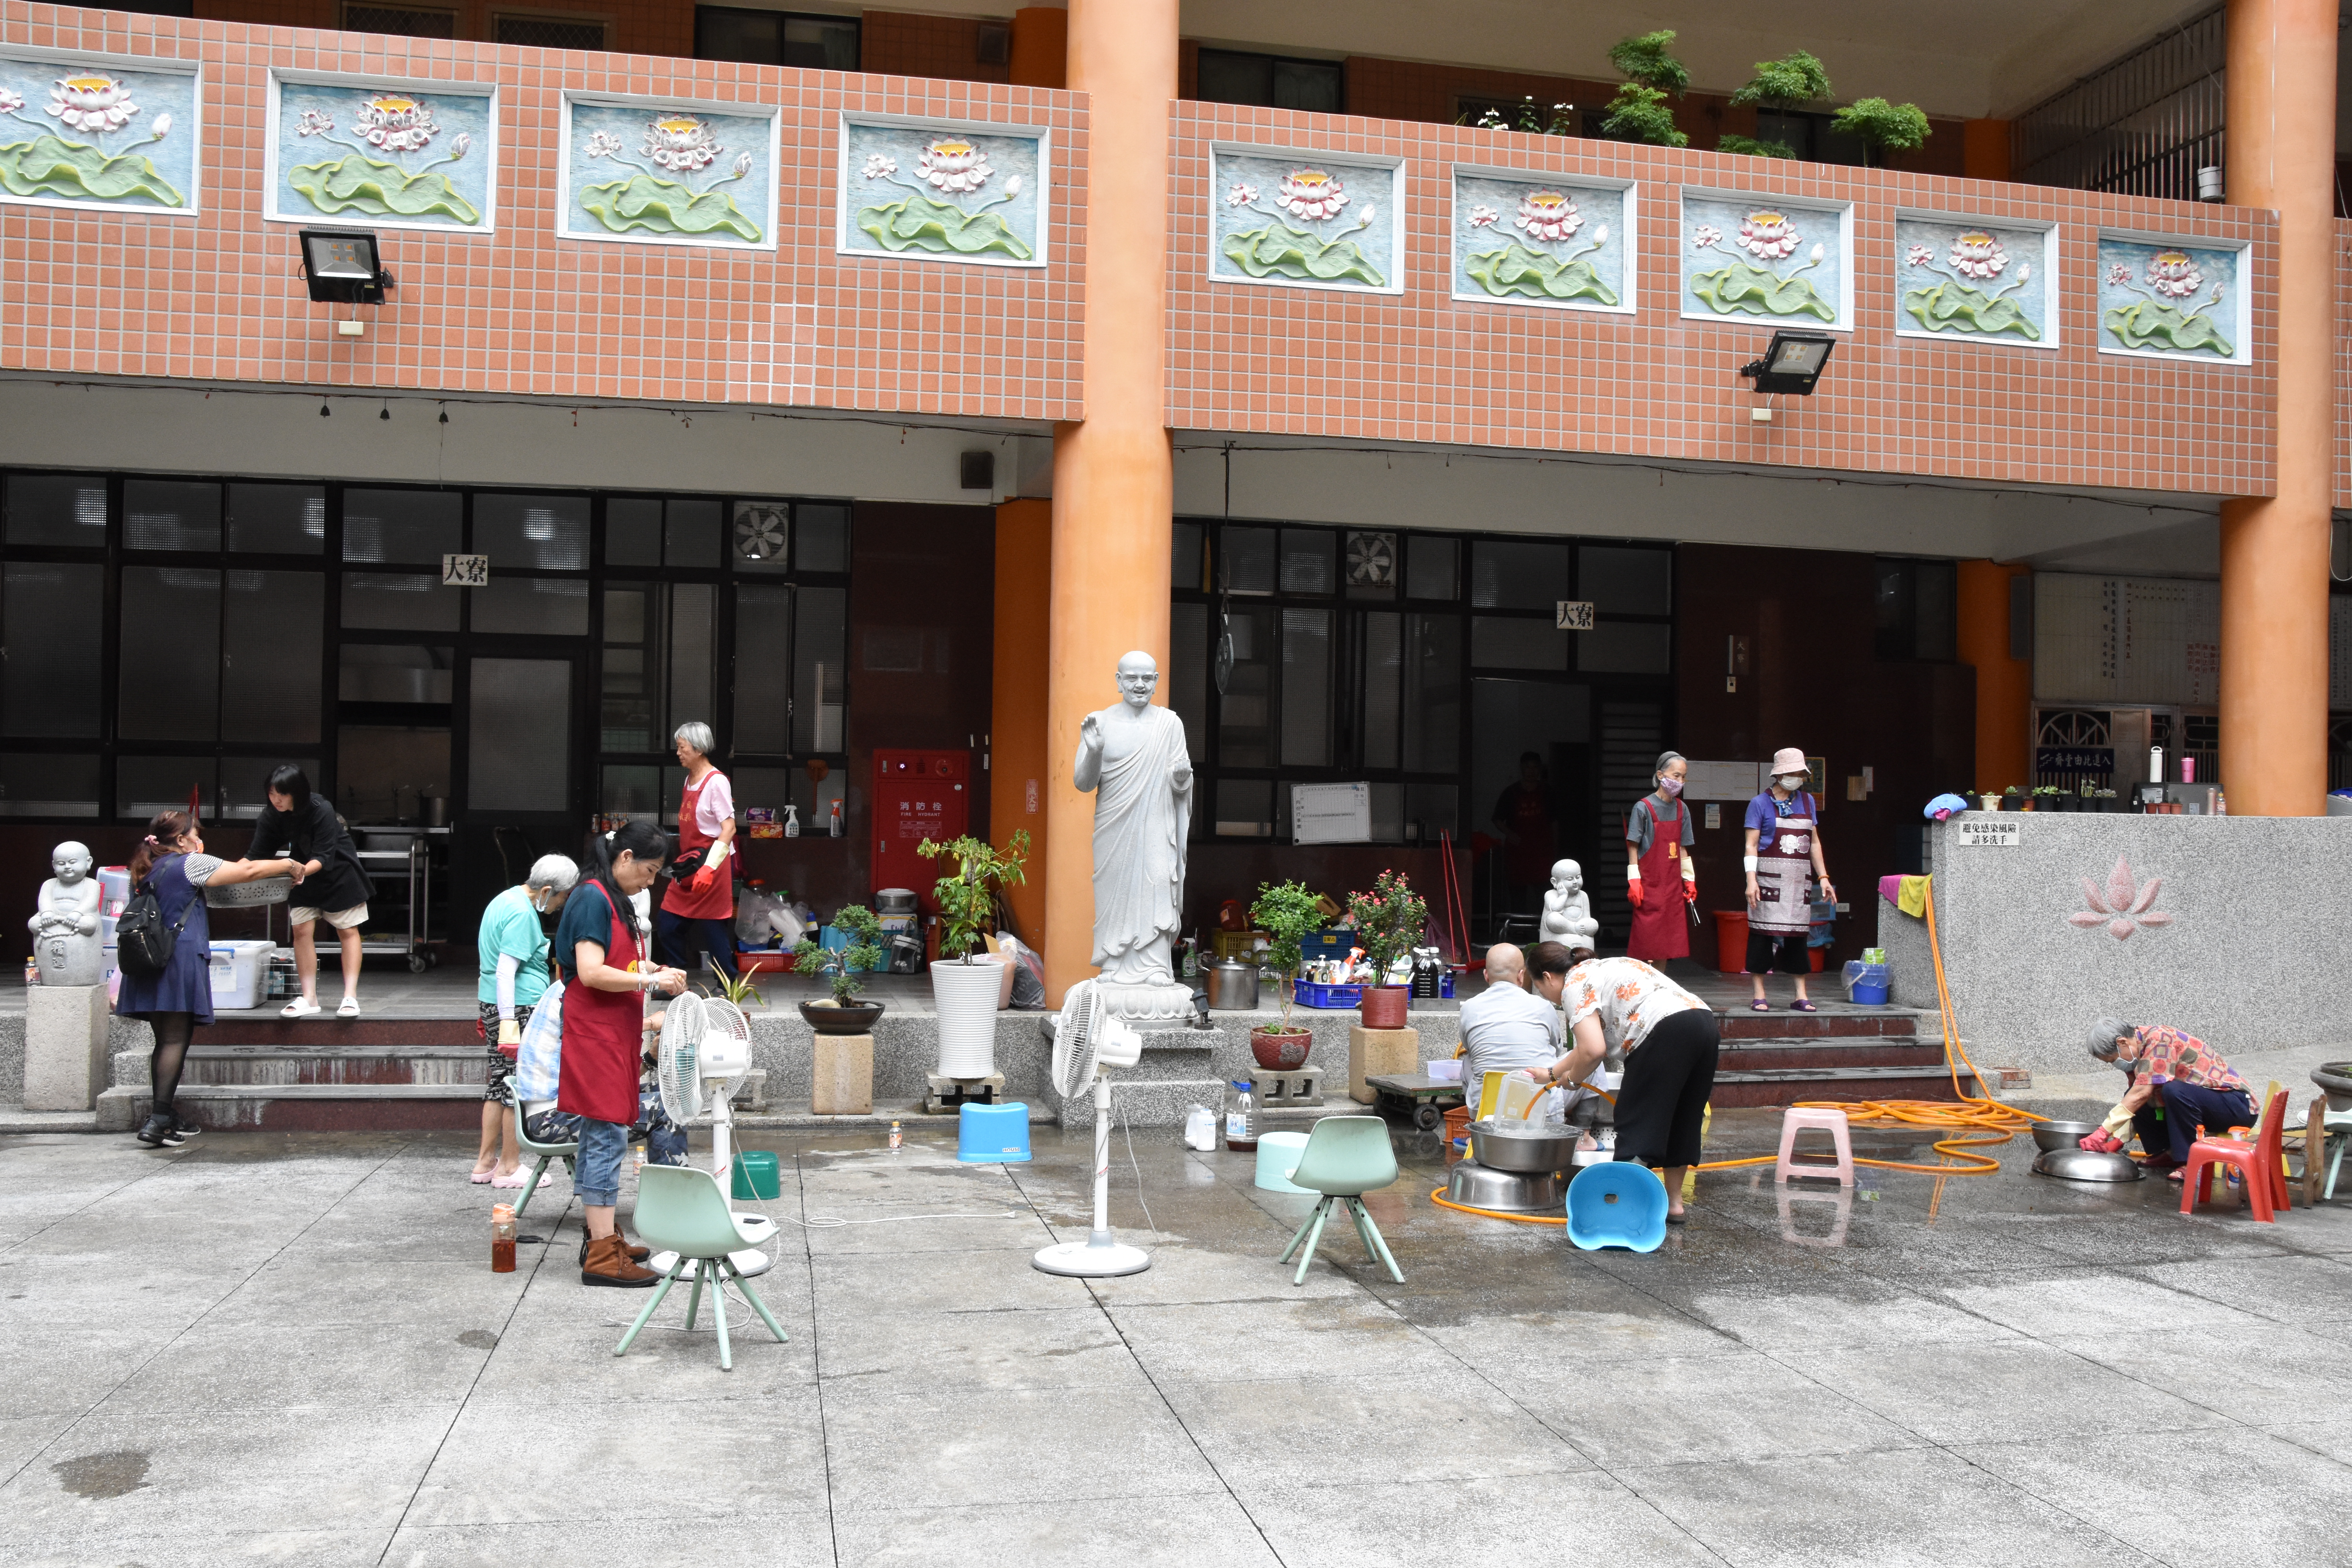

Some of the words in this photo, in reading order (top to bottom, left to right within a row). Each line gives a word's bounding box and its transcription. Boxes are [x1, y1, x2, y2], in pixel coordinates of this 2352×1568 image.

[444, 556, 486, 583] 大寮
[1557, 603, 1593, 627] 大寮
[1737, 641, 1745, 663] 大寮
[900, 802, 942, 811] 消防栓
[1962, 823, 2016, 833] 避免感染風險
[1972, 835, 2007, 845] 請多洗手
[51, 942, 65, 968] 精進
